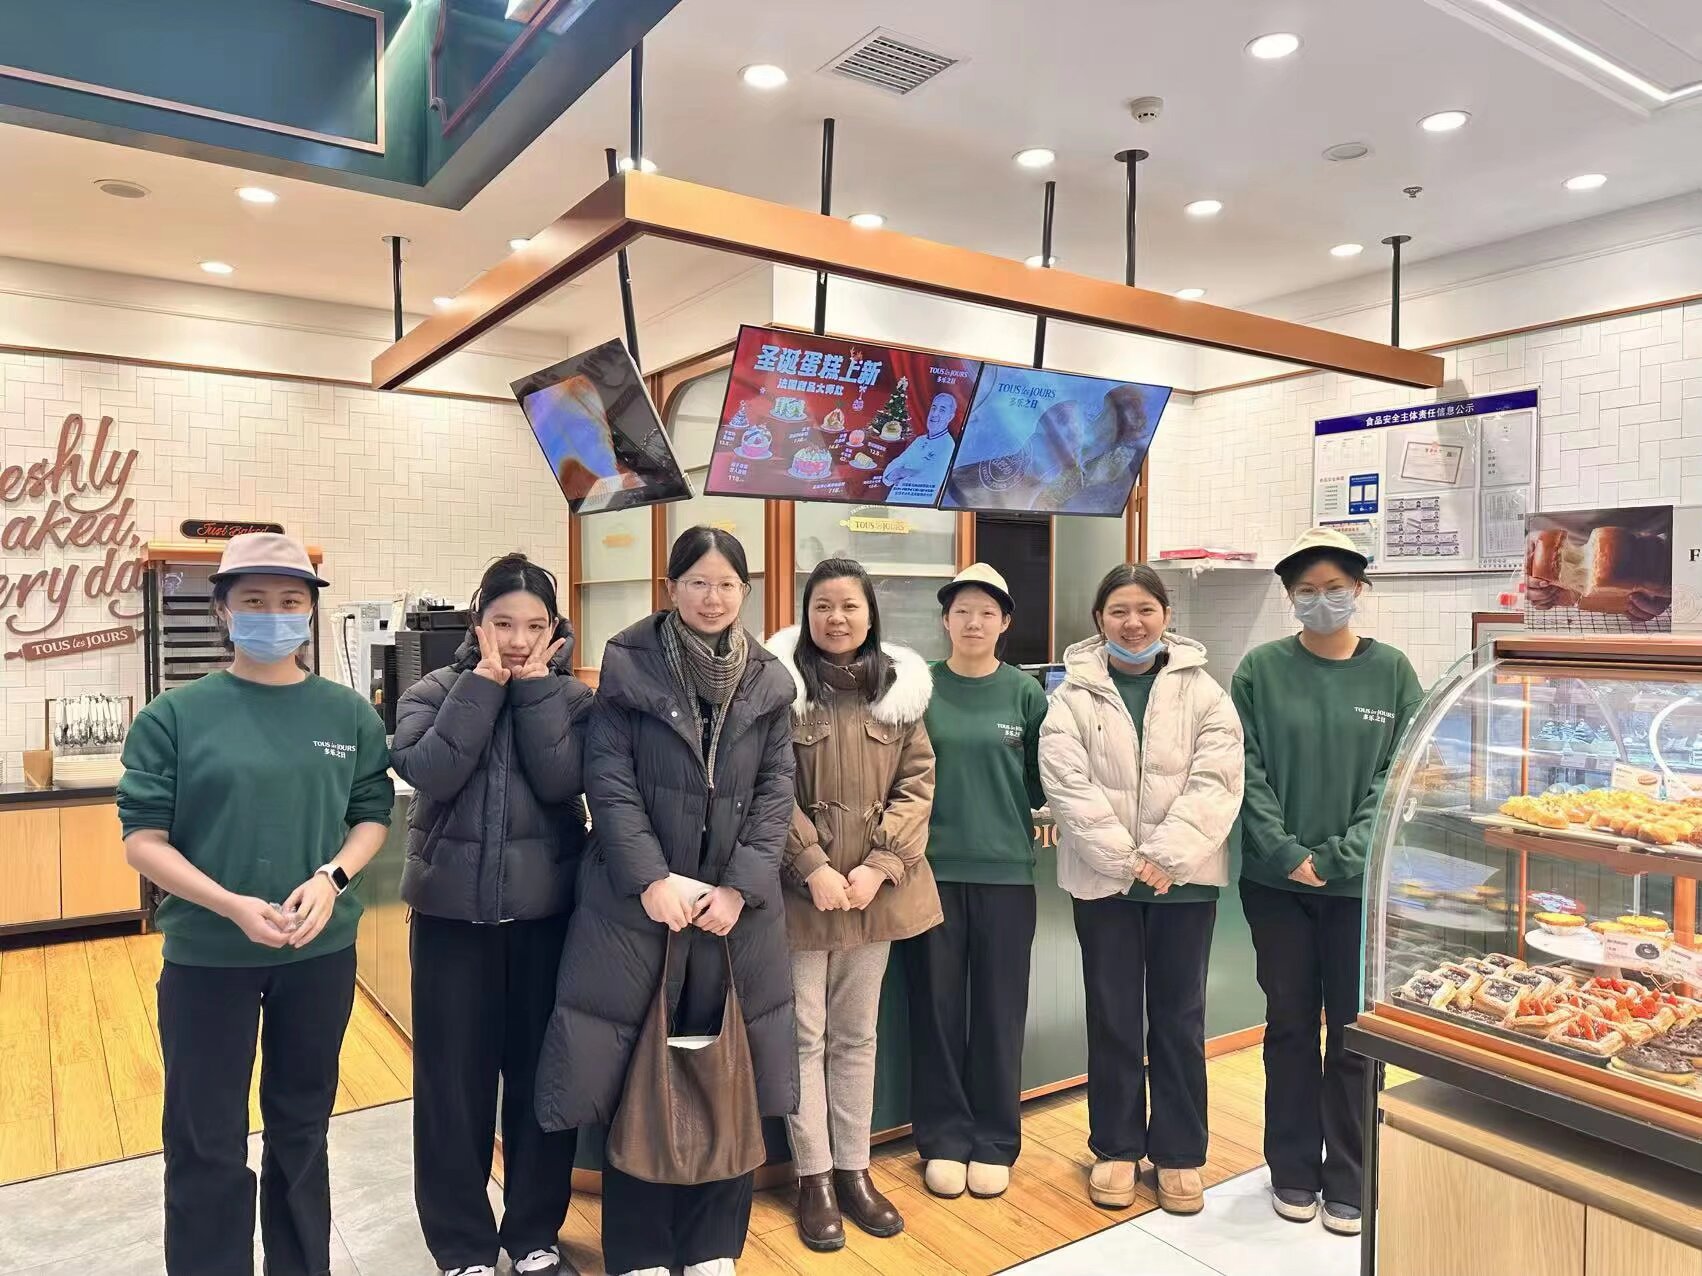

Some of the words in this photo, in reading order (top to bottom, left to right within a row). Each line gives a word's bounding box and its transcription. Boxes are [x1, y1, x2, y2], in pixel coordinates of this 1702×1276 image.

[754, 344, 883, 386] 圣诞蛋糕上新
[929, 366, 945, 375] TOUS
[950, 370, 969, 378] JOURS
[998, 383, 1021, 395] TOUS
[1029, 387, 1057, 399] JOURS
[1365, 403, 1475, 427] 食品安全主体责任信息公示
[0, 413, 139, 513] eshly
[1, 497, 141, 550] aked,
[197, 522, 228, 536] Just
[855, 520, 875, 529] TOUS
[32, 641, 71, 656] TOUS
[72, 637, 86, 649] les
[86, 629, 129, 648] JOURS
[1353, 706, 1371, 714] TOUS
[1377, 709, 1395, 719] JOURS
[312, 740, 331, 748] TOUS
[337, 744, 356, 752] JOURS
